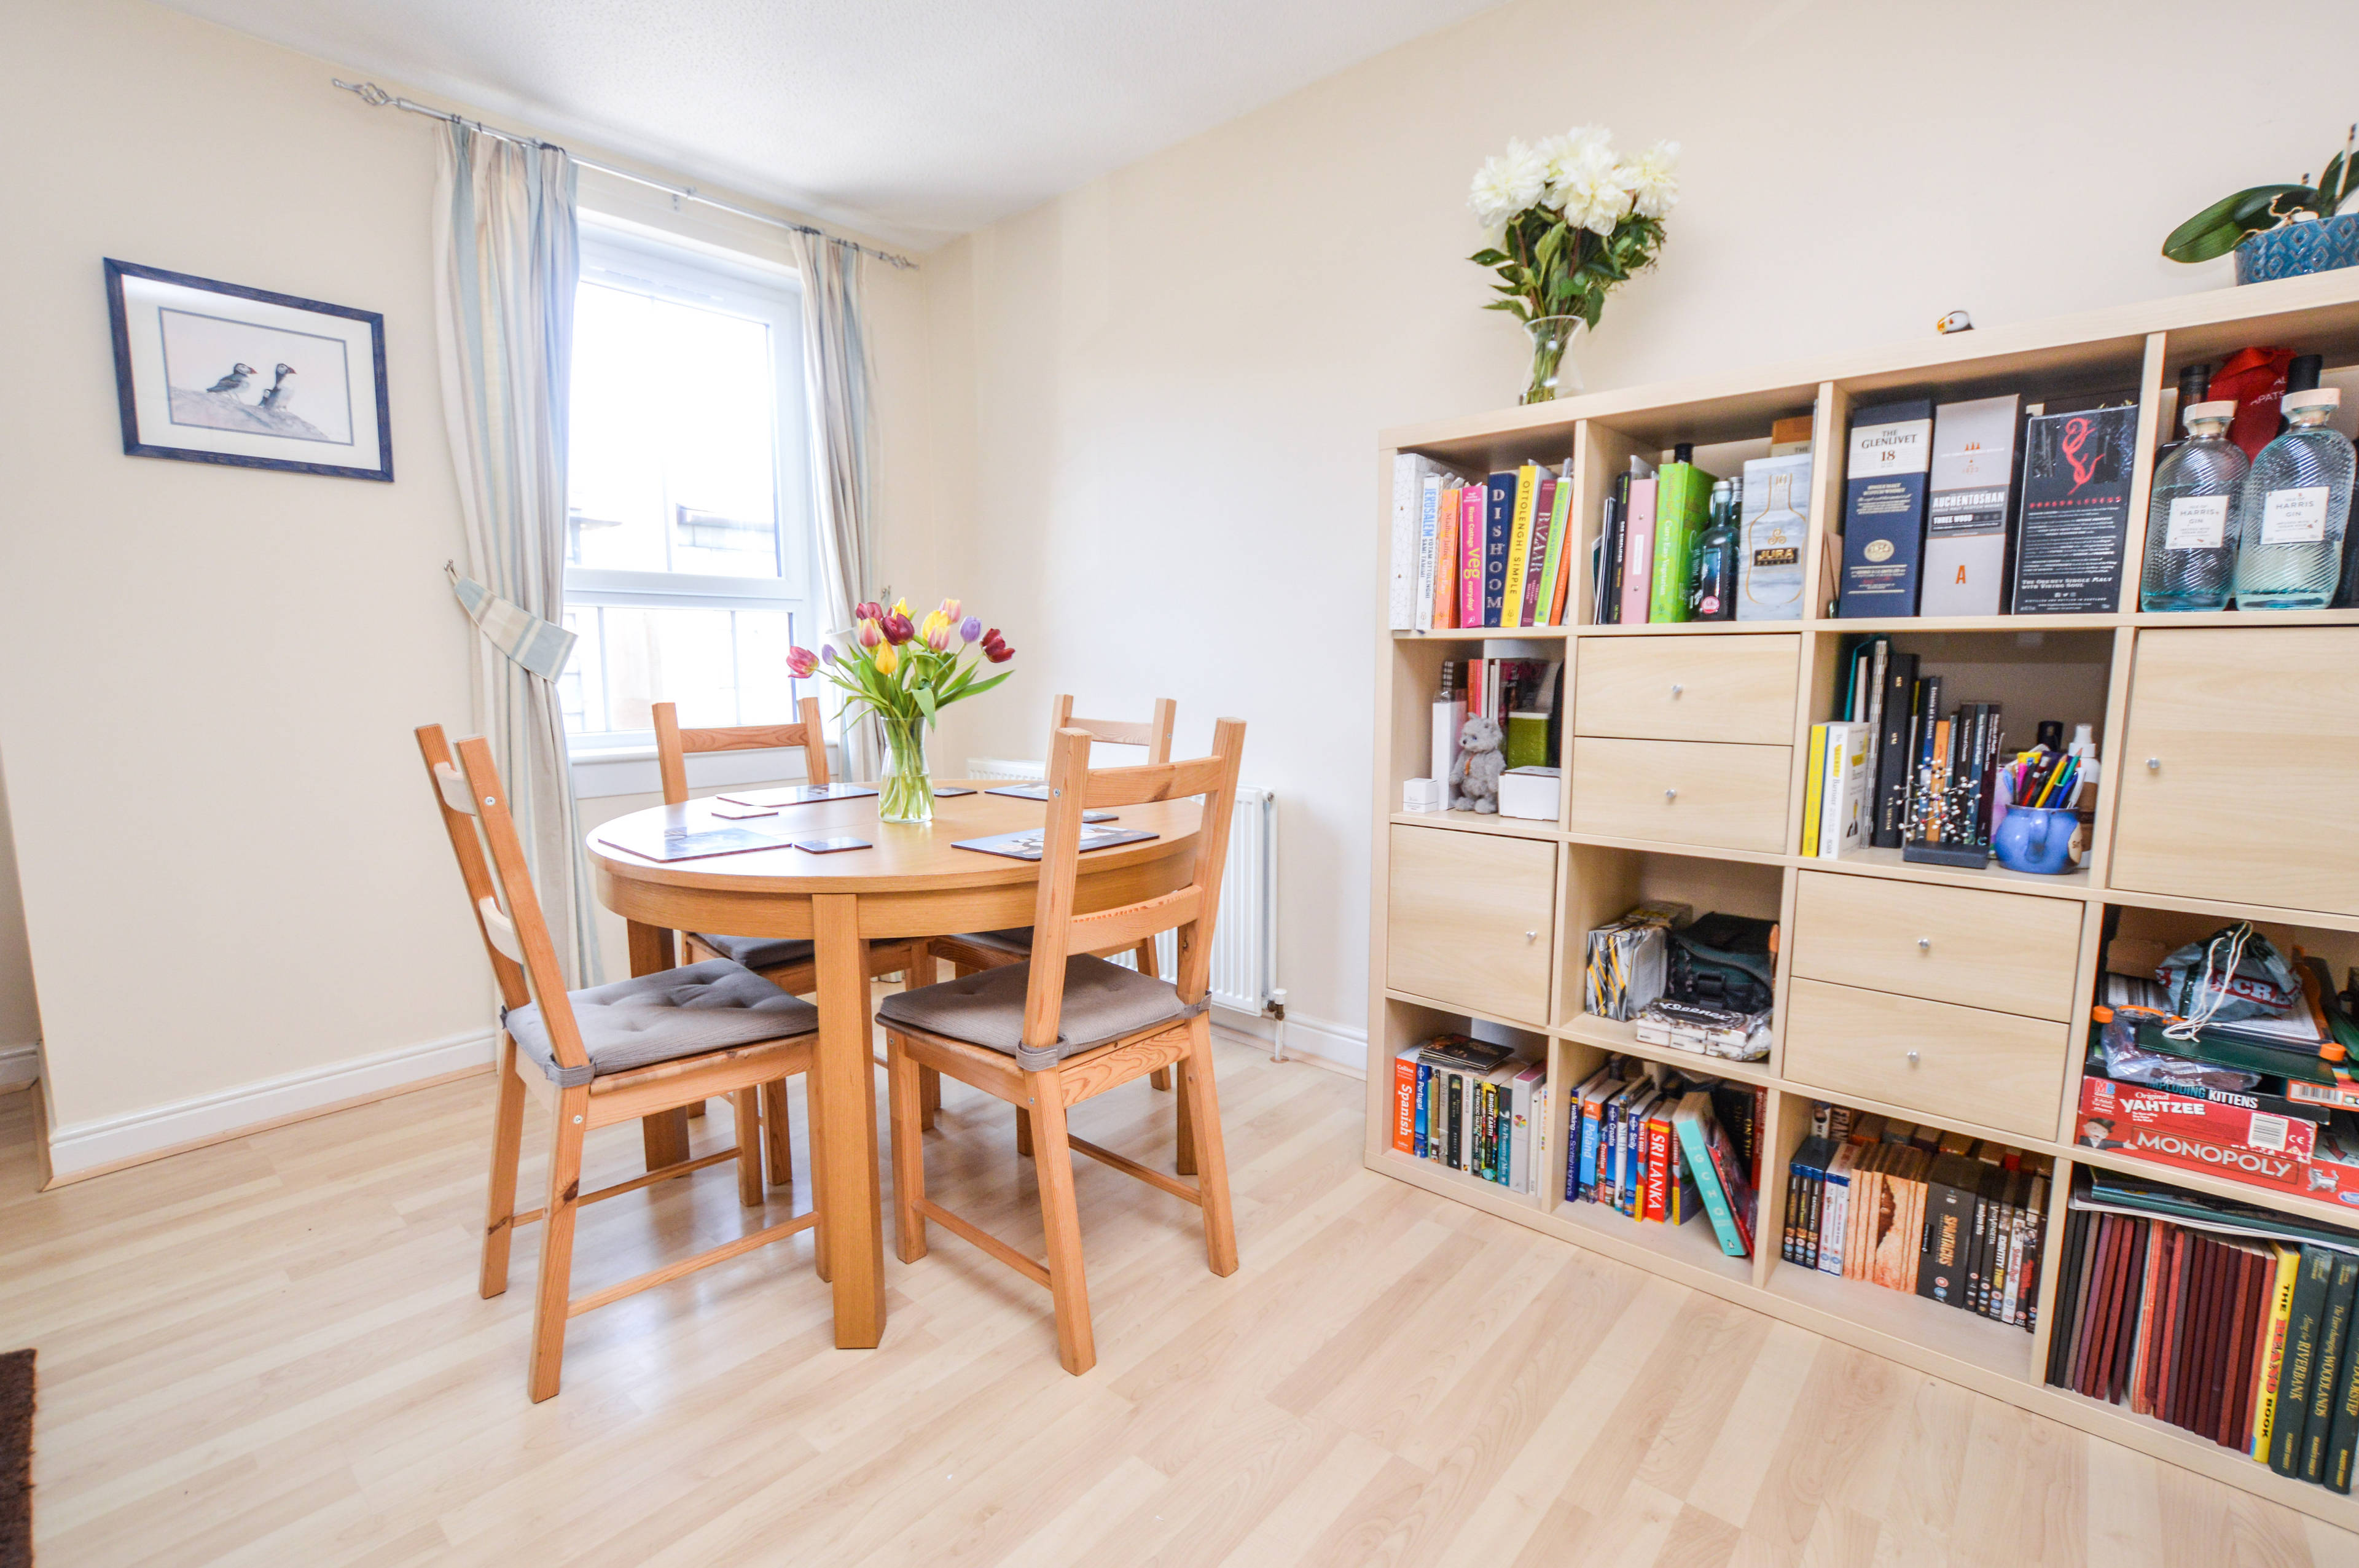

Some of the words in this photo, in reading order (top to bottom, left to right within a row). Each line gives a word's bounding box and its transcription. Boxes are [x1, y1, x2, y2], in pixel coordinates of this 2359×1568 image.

[1861, 434, 1917, 449] GLENLIVET
[1880, 450, 1896, 462] 18
[1422, 488, 1436, 537] JERUSALEM
[1933, 491, 2005, 509] AUCHENTOSHAN
[1517, 480, 1530, 552] OTTOLENGHI
[1554, 504, 1563, 527] GREEN
[1933, 515, 1954, 525] THREE
[1954, 514, 1974, 523] WOOD
[1530, 511, 1551, 573] BAZAAR
[1663, 520, 1672, 542] Curry
[1487, 489, 1506, 609] DISHOOM
[1662, 542, 1670, 558] Easy
[1758, 549, 1794, 561] JURA
[1464, 547, 1481, 579] veg
[1956, 564, 1966, 584] A
[1509, 557, 1522, 595] SIMPLE
[1660, 559, 1670, 596] Vegetarian
[1929, 687, 1938, 706] Estonia
[1927, 720, 1935, 739] Glance
[1830, 779, 1840, 806] Barrister
[1659, 1002, 1732, 1021] Kleenex
[1397, 1064, 1414, 1074] Collins
[1417, 1081, 1425, 1110] Portugal
[2095, 1080, 2116, 1094] MB
[2135, 1091, 2170, 1100] Original
[2208, 1089, 2259, 1109] KITTENS
[1398, 1084, 1412, 1136] Spanish
[2120, 1098, 2206, 1116] YAHTZEE
[1744, 1118, 1753, 1135] ON
[1583, 1123, 1596, 1159] Poland
[1651, 1134, 1665, 1158] SRI
[2136, 1132, 2292, 1178] MONOPOLY
[1648, 1160, 1664, 1209] LANKA
[1938, 1215, 1958, 1267] SPARTACUS
[1988, 1219, 1997, 1245] VENDETTA
[1995, 1235, 2008, 1268] IDENTITY
[1993, 1268, 2005, 1290] THIEF
[2279, 1283, 2290, 1313] THE
[2336, 1305, 2345, 1319] The
[2301, 1314, 2314, 1337] Along
[2265, 1317, 2288, 1394] BEANO
[2289, 1340, 2311, 1402] RIVERBANK
[2314, 1352, 2337, 1418] WOODLANDS
[2345, 1363, 2359, 1418] DOORSTEP
[2261, 1397, 2274, 1439] BOOK
